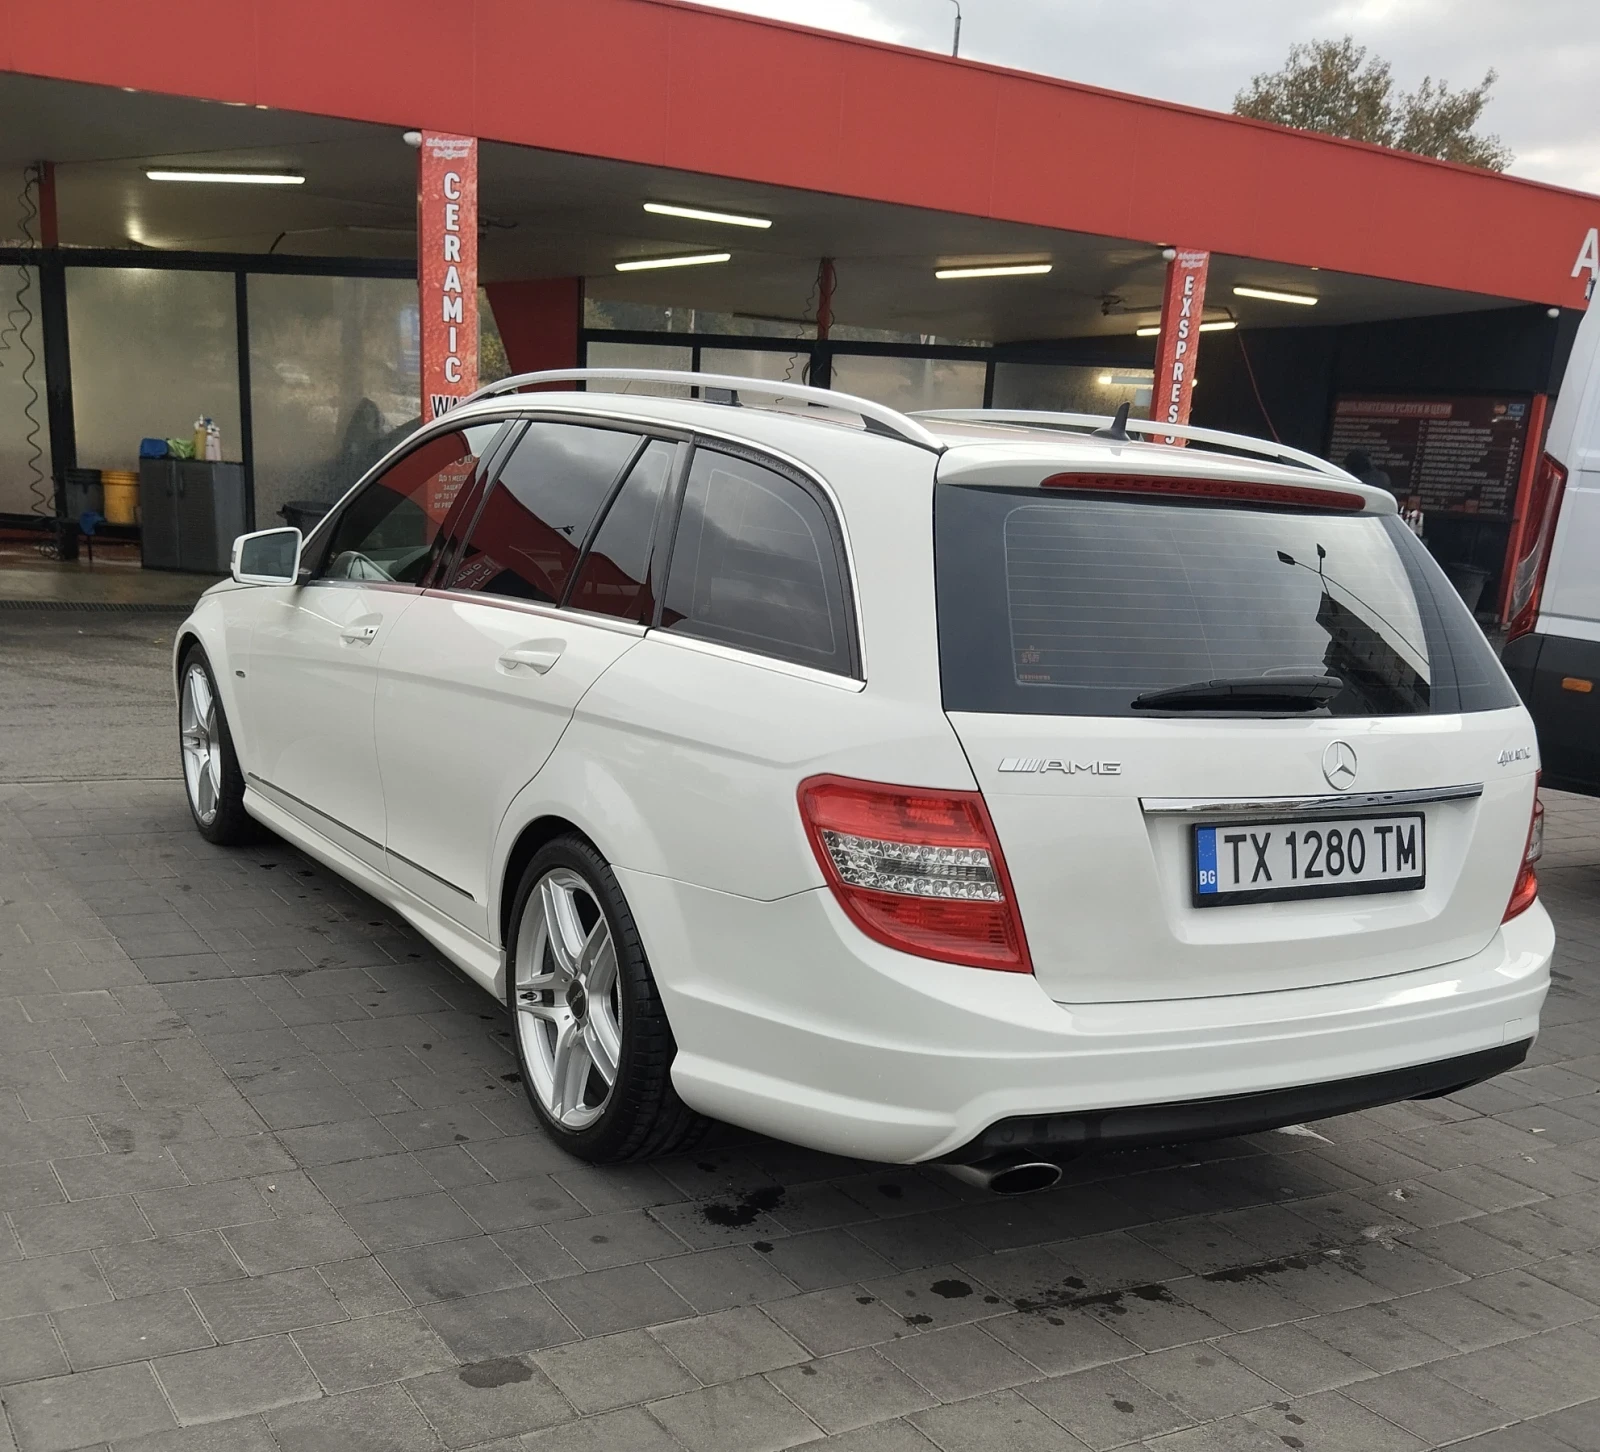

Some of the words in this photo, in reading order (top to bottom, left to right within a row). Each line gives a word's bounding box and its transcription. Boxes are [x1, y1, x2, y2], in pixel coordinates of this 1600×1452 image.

[443, 171, 463, 385] CERAMIC
[1040, 759, 1122, 775] AMG
[1224, 832, 1273, 884] TX
[1285, 827, 1366, 880] 1280
[1373, 824, 1417, 873] TM
[1199, 870, 1217, 886] BG
